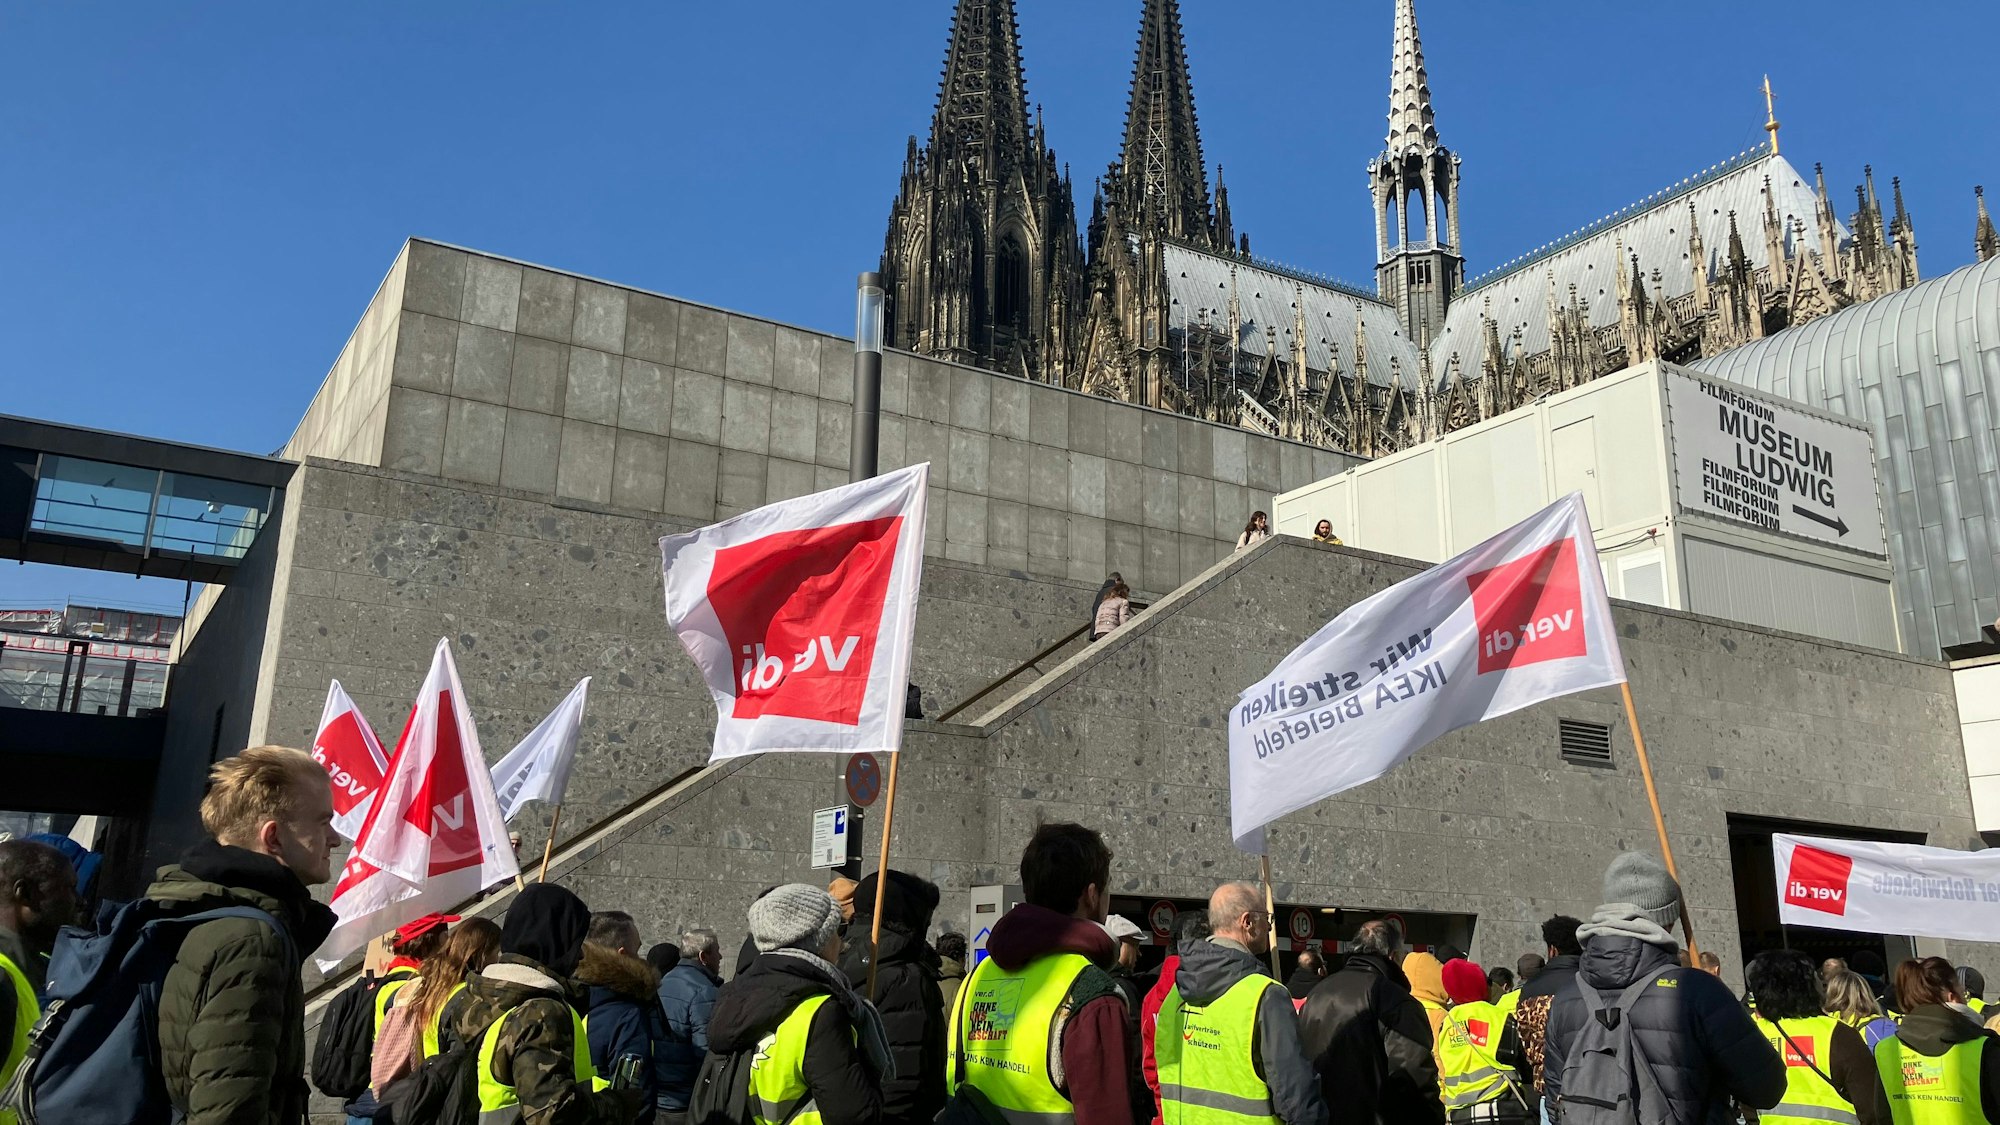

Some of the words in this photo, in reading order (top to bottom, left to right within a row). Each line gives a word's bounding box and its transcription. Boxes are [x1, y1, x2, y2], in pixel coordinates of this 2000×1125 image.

[1700, 382, 1775, 424] FILMFORUM
[1719, 404, 1833, 478] MUSEUM
[1702, 458, 1778, 501] FILMFORUM
[1736, 443, 1835, 508] LUDWIG
[1703, 474, 1780, 516] FILMFORUM
[1704, 489, 1780, 531] FILMFORUM
[1296, 917, 1308, 932] 10
[974, 1001, 997, 1013] OHNE
[969, 1011, 987, 1022] UNS
[971, 1020, 994, 1032] KEIN
[1187, 1038, 1221, 1051] schützen!
[997, 1059, 1031, 1074] HANDEL!
[1935, 1095, 1964, 1103] HANDEL!
